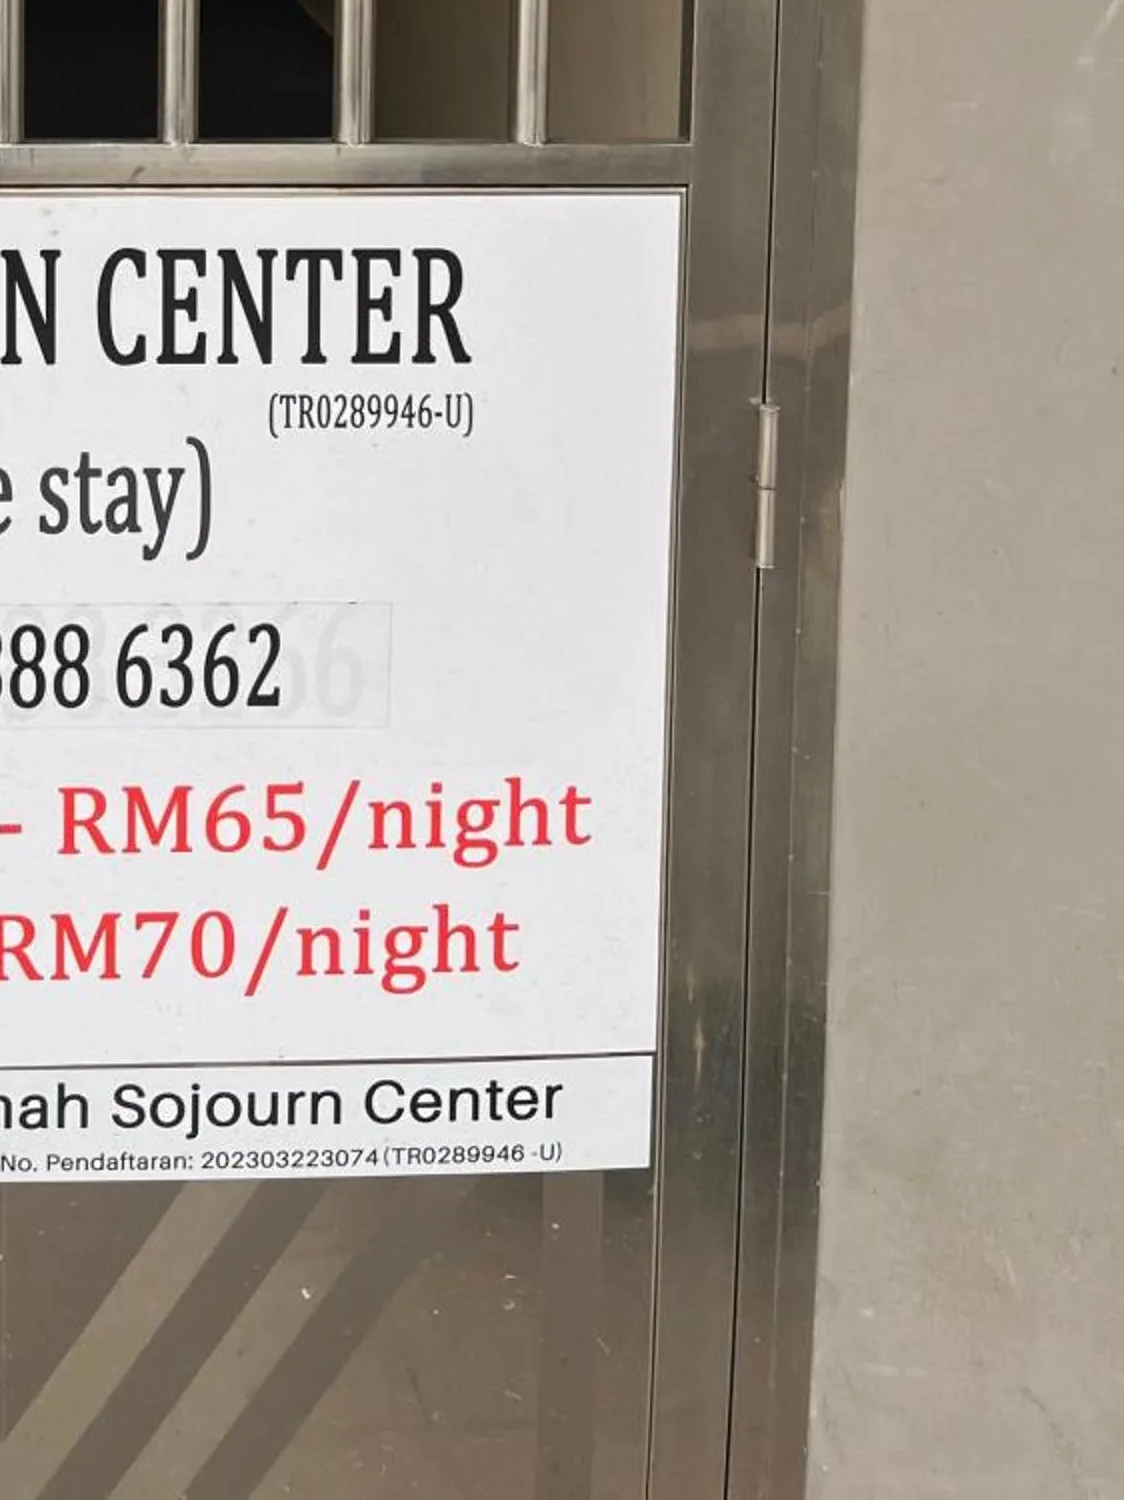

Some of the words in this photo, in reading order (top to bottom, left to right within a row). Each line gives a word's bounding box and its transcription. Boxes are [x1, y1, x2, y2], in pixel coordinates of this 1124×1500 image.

[97, 247, 473, 366] CENTER
[269, 393, 473, 438] (TR0289946-U)
[39, 436, 211, 561] stay)
[116, 623, 281, 709] 6362
[58, 777, 592, 871] RM65/night
[112, 1082, 342, 1141] Sojourn
[365, 1079, 564, 1125] Center
[0, 1154, 37, 1172] No.
[47, 1152, 194, 1171] Pendaftaran:
